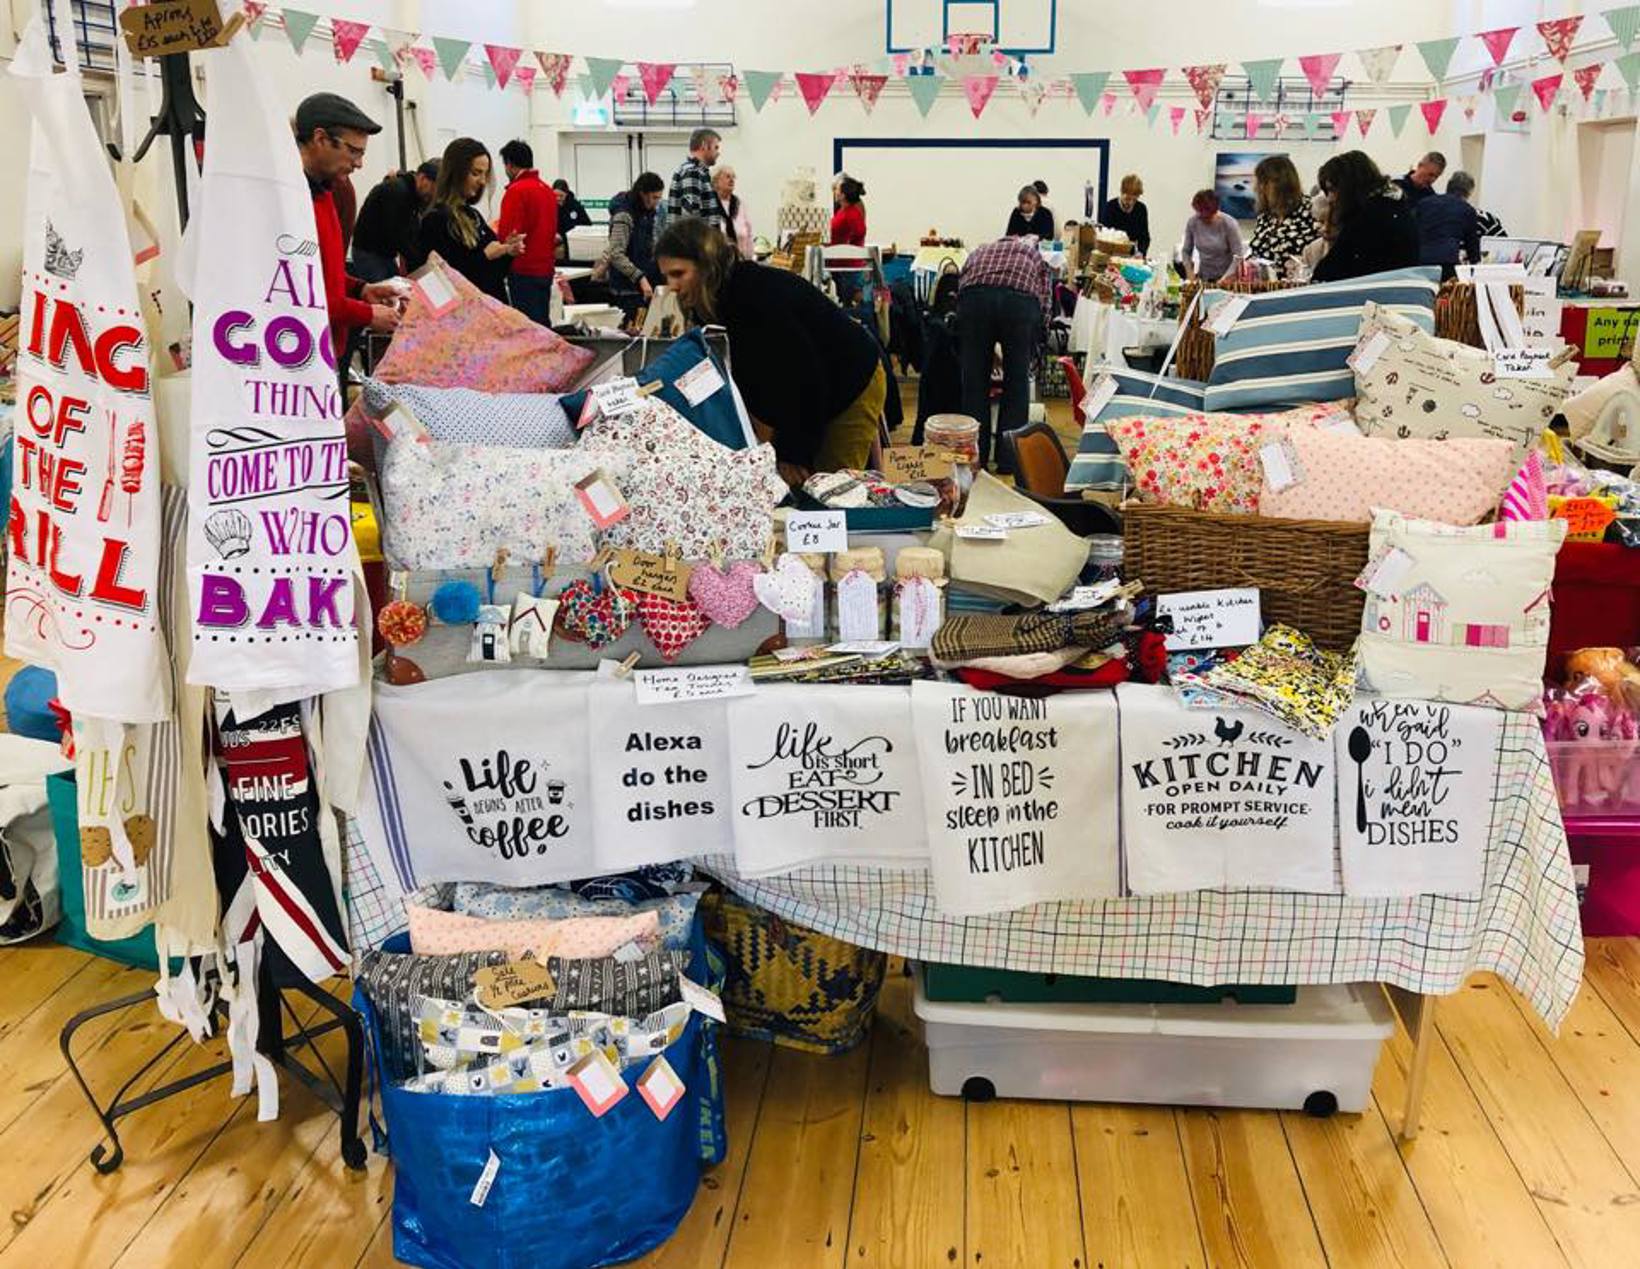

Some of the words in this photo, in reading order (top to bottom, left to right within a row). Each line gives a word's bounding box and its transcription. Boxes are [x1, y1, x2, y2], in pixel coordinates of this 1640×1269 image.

[1595, 317, 1617, 328] Any
[26, 385, 91, 447] OF
[17, 436, 87, 513] THE
[207, 450, 278, 500] COME
[284, 444, 314, 487] TO
[259, 507, 349, 556] WHO
[197, 573, 357, 629] BAK
[951, 697, 967, 722] IF
[972, 697, 1002, 721] YOU
[1007, 697, 1048, 720] WANT
[625, 732, 702, 751] Alexa
[750, 722, 860, 769] life
[945, 726, 1058, 753] breakfast
[815, 753, 830, 769] is
[834, 749, 880, 769] short
[1132, 751, 1325, 789] KITCHEN
[236, 772, 295, 803] FINE
[459, 750, 537, 799] Life
[622, 767, 656, 786] do
[664, 765, 708, 784] the
[787, 769, 860, 790] EAT
[971, 763, 994, 799] IN
[1001, 761, 1034, 798] BED
[1166, 781, 1221, 797] OPEN
[1229, 781, 1288, 796] DAILY
[627, 799, 715, 822] dishes
[743, 789, 900, 819] DESSERT
[946, 803, 1000, 830] sleep
[1023, 799, 1059, 822] the
[1147, 803, 1177, 815] FOR
[1181, 801, 1241, 814] PROMPT
[1244, 801, 1310, 815] SERVICE
[1381, 801, 1432, 819] mean
[466, 815, 570, 859] coffee
[1166, 816, 1203, 830] cook
[1206, 815, 1218, 828] it
[1219, 816, 1289, 830] yourself
[1366, 820, 1459, 846] DISHES
[967, 830, 1045, 873] KITCHEN
